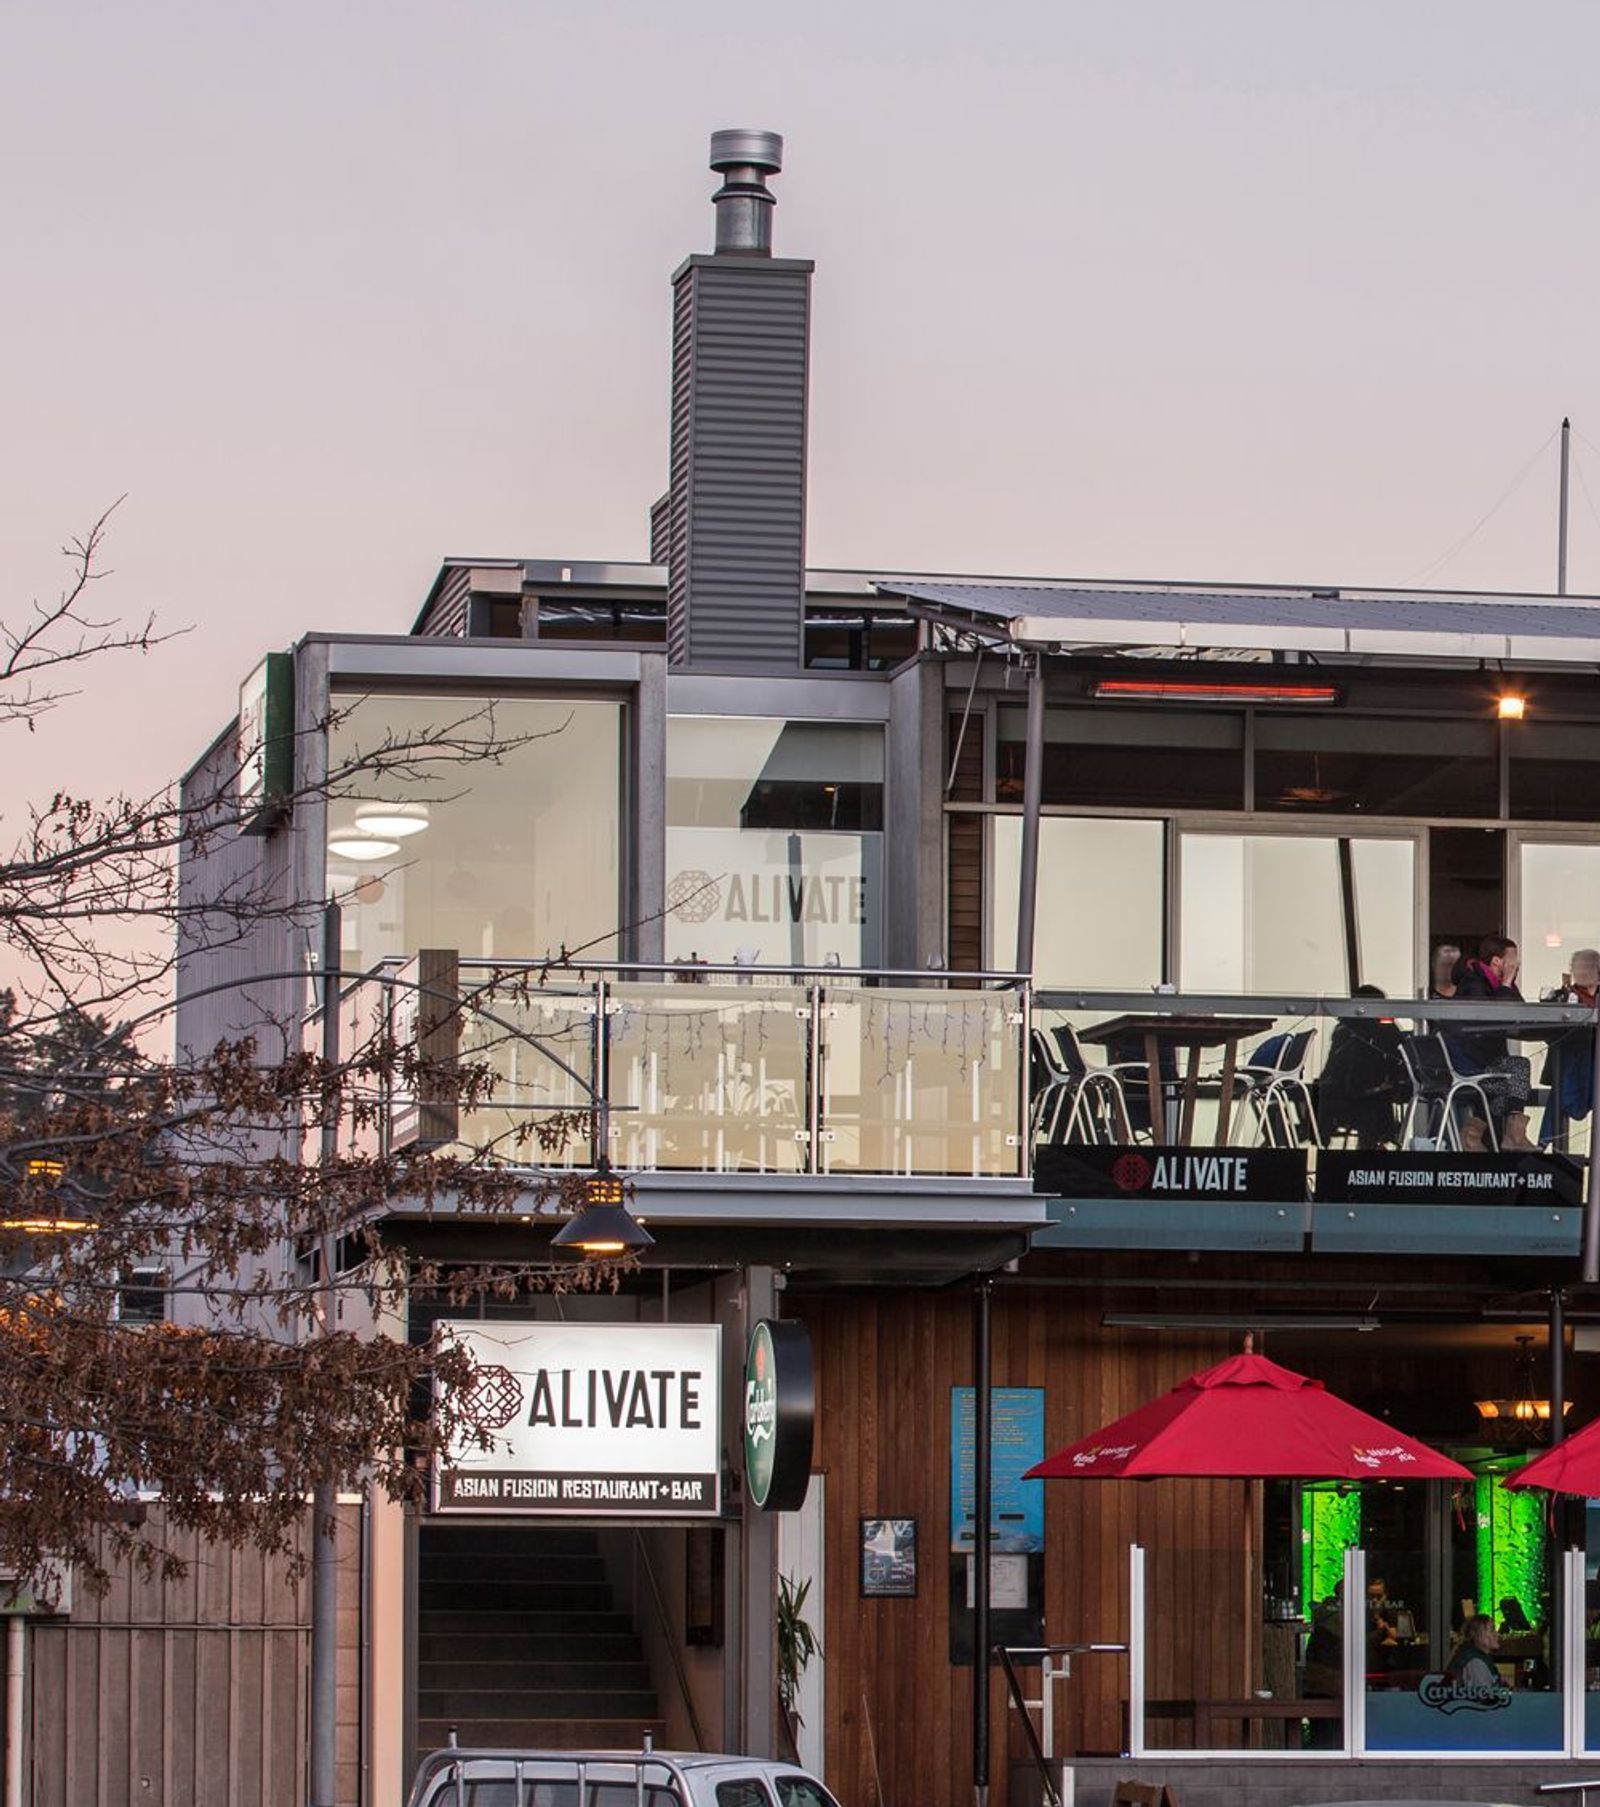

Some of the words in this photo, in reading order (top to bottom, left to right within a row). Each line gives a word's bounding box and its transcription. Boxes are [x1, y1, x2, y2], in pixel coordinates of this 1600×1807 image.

[724, 874, 867, 924] ALIVATE
[1152, 1156, 1248, 1190] ALIVATE
[1347, 1170, 1384, 1186] ASIAN
[1388, 1171, 1433, 1187] FUSION
[528, 1368, 702, 1429] ALIVATE
[454, 1478, 499, 1498] ASIAN
[503, 1478, 558, 1498] FUSION
